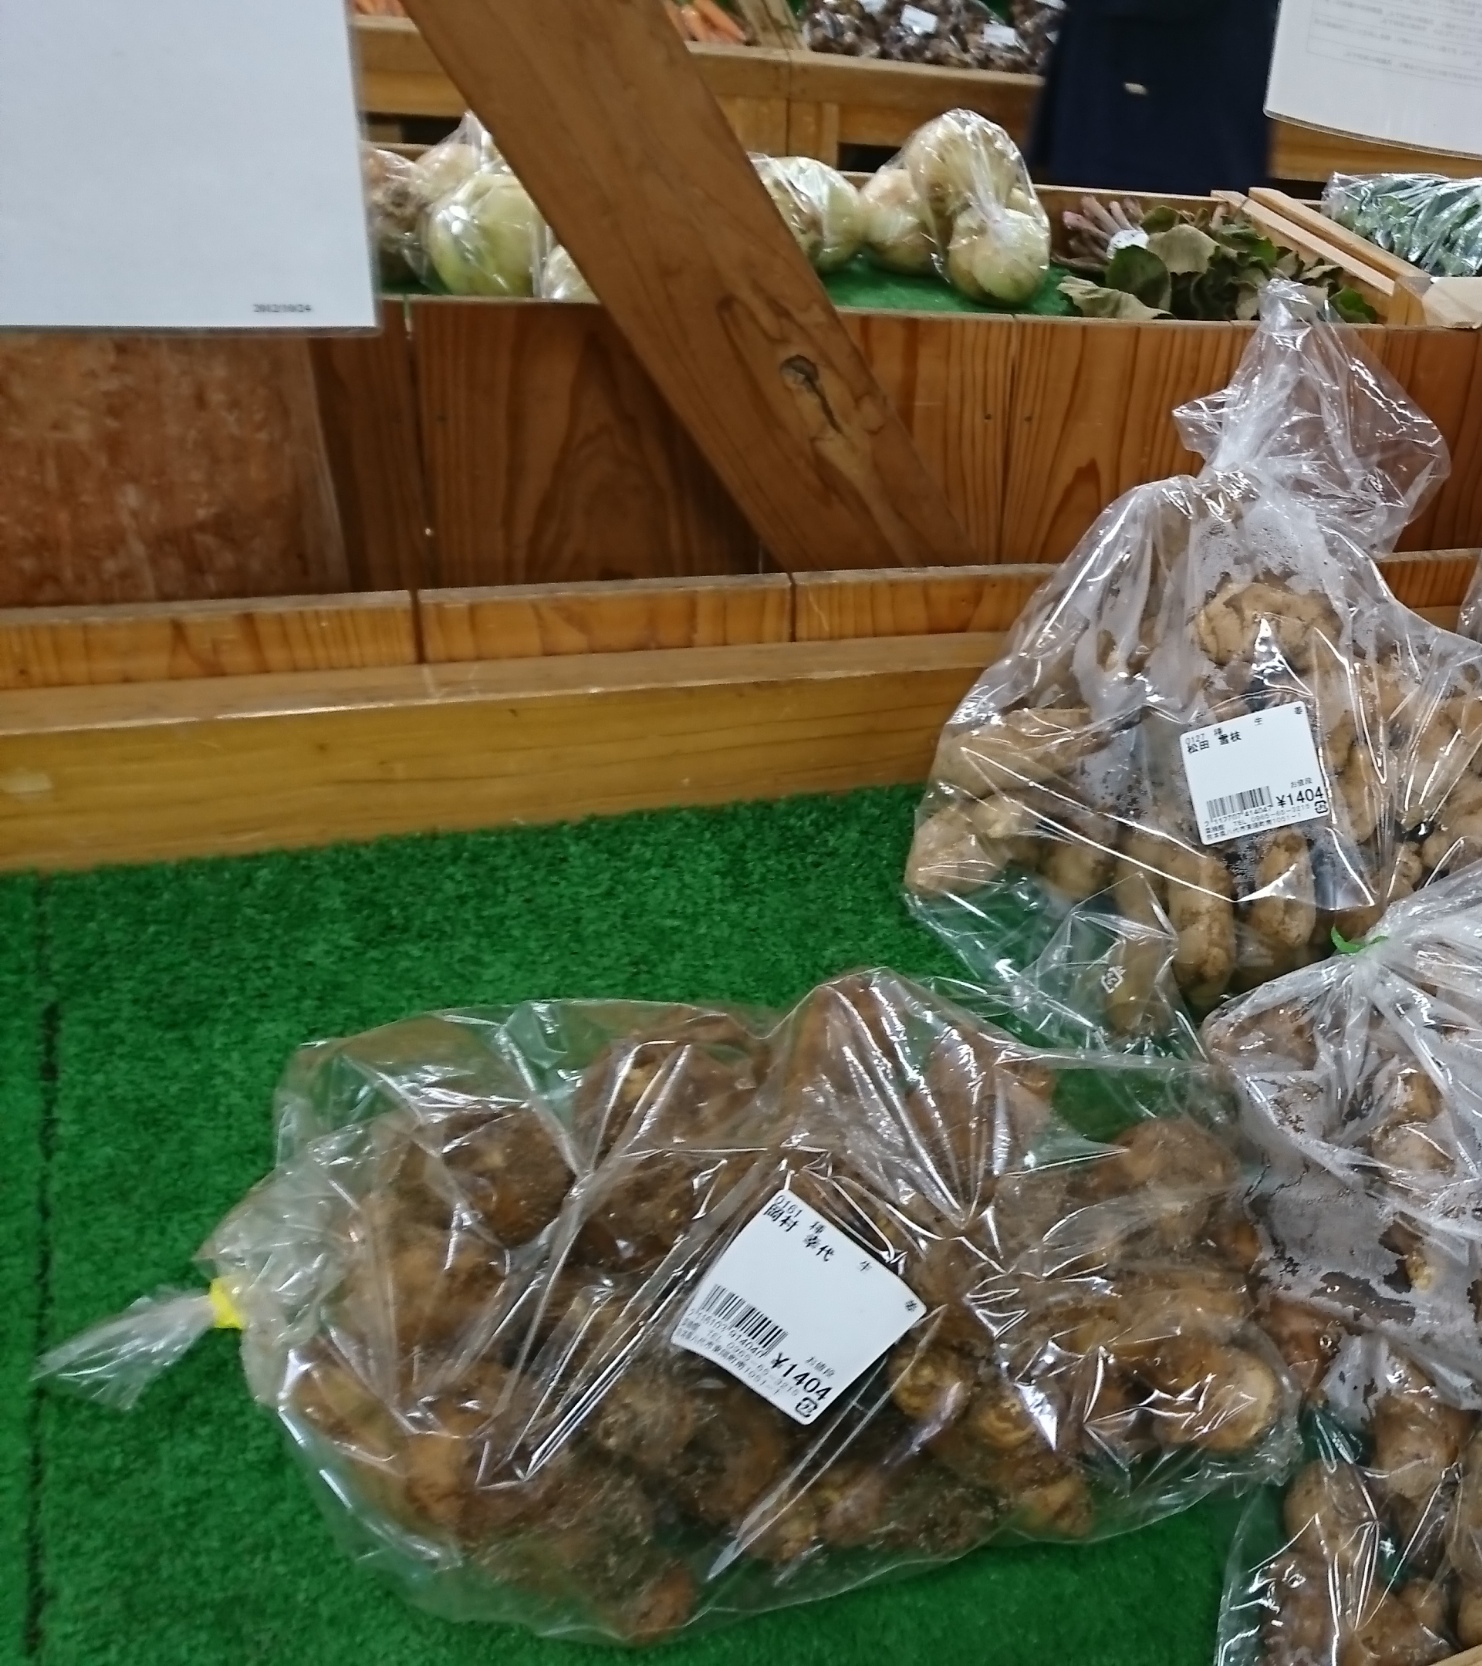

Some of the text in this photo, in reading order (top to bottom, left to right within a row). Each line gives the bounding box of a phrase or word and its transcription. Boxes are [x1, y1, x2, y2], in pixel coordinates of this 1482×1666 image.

[1187, 740, 1210, 754] 松田
[1276, 786, 1323, 808] ¥1404
[774, 1194, 802, 1218] 0161
[765, 1205, 834, 1262] 岡村 幸代
[770, 1354, 832, 1401] ¥1404
